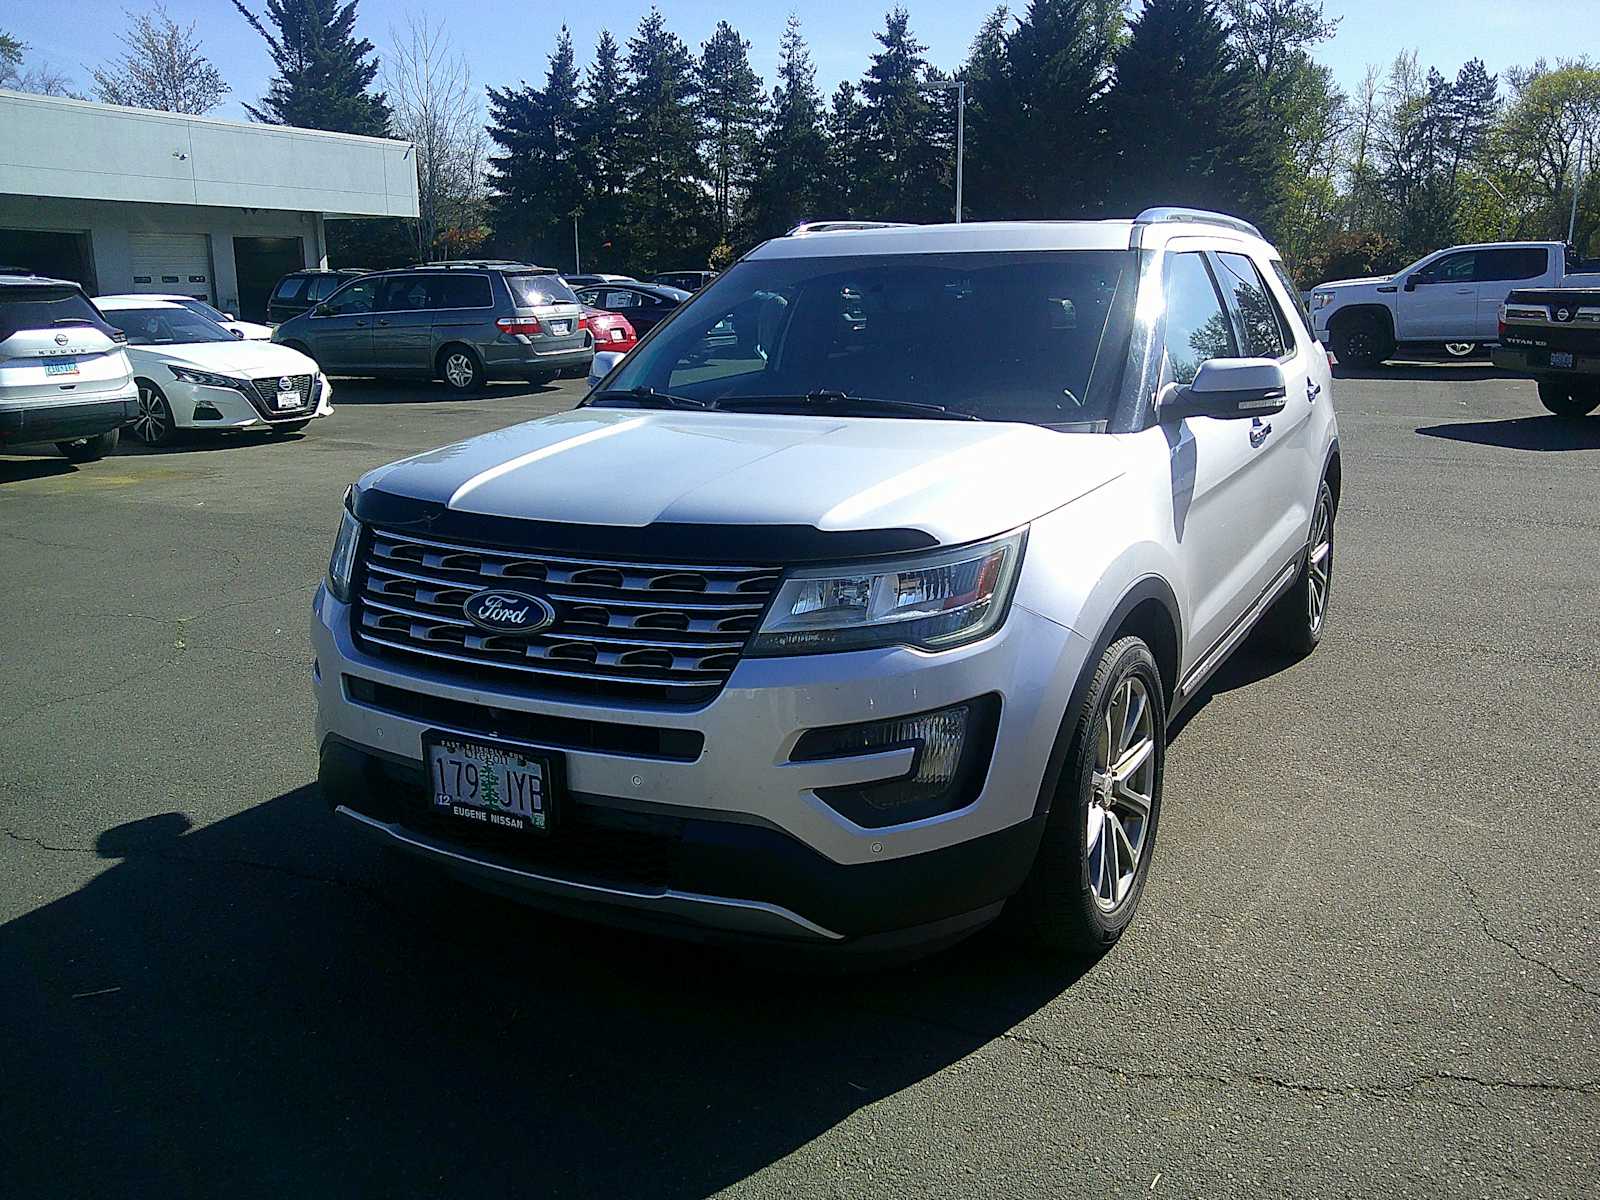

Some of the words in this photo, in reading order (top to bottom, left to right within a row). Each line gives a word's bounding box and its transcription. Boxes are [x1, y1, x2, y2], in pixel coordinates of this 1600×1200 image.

[479, 595, 529, 623] Ford
[436, 757, 479, 799] 179
[437, 794, 451, 806] 12
[453, 806, 487, 822] EUGENE
[490, 814, 524, 829] NISSAN
